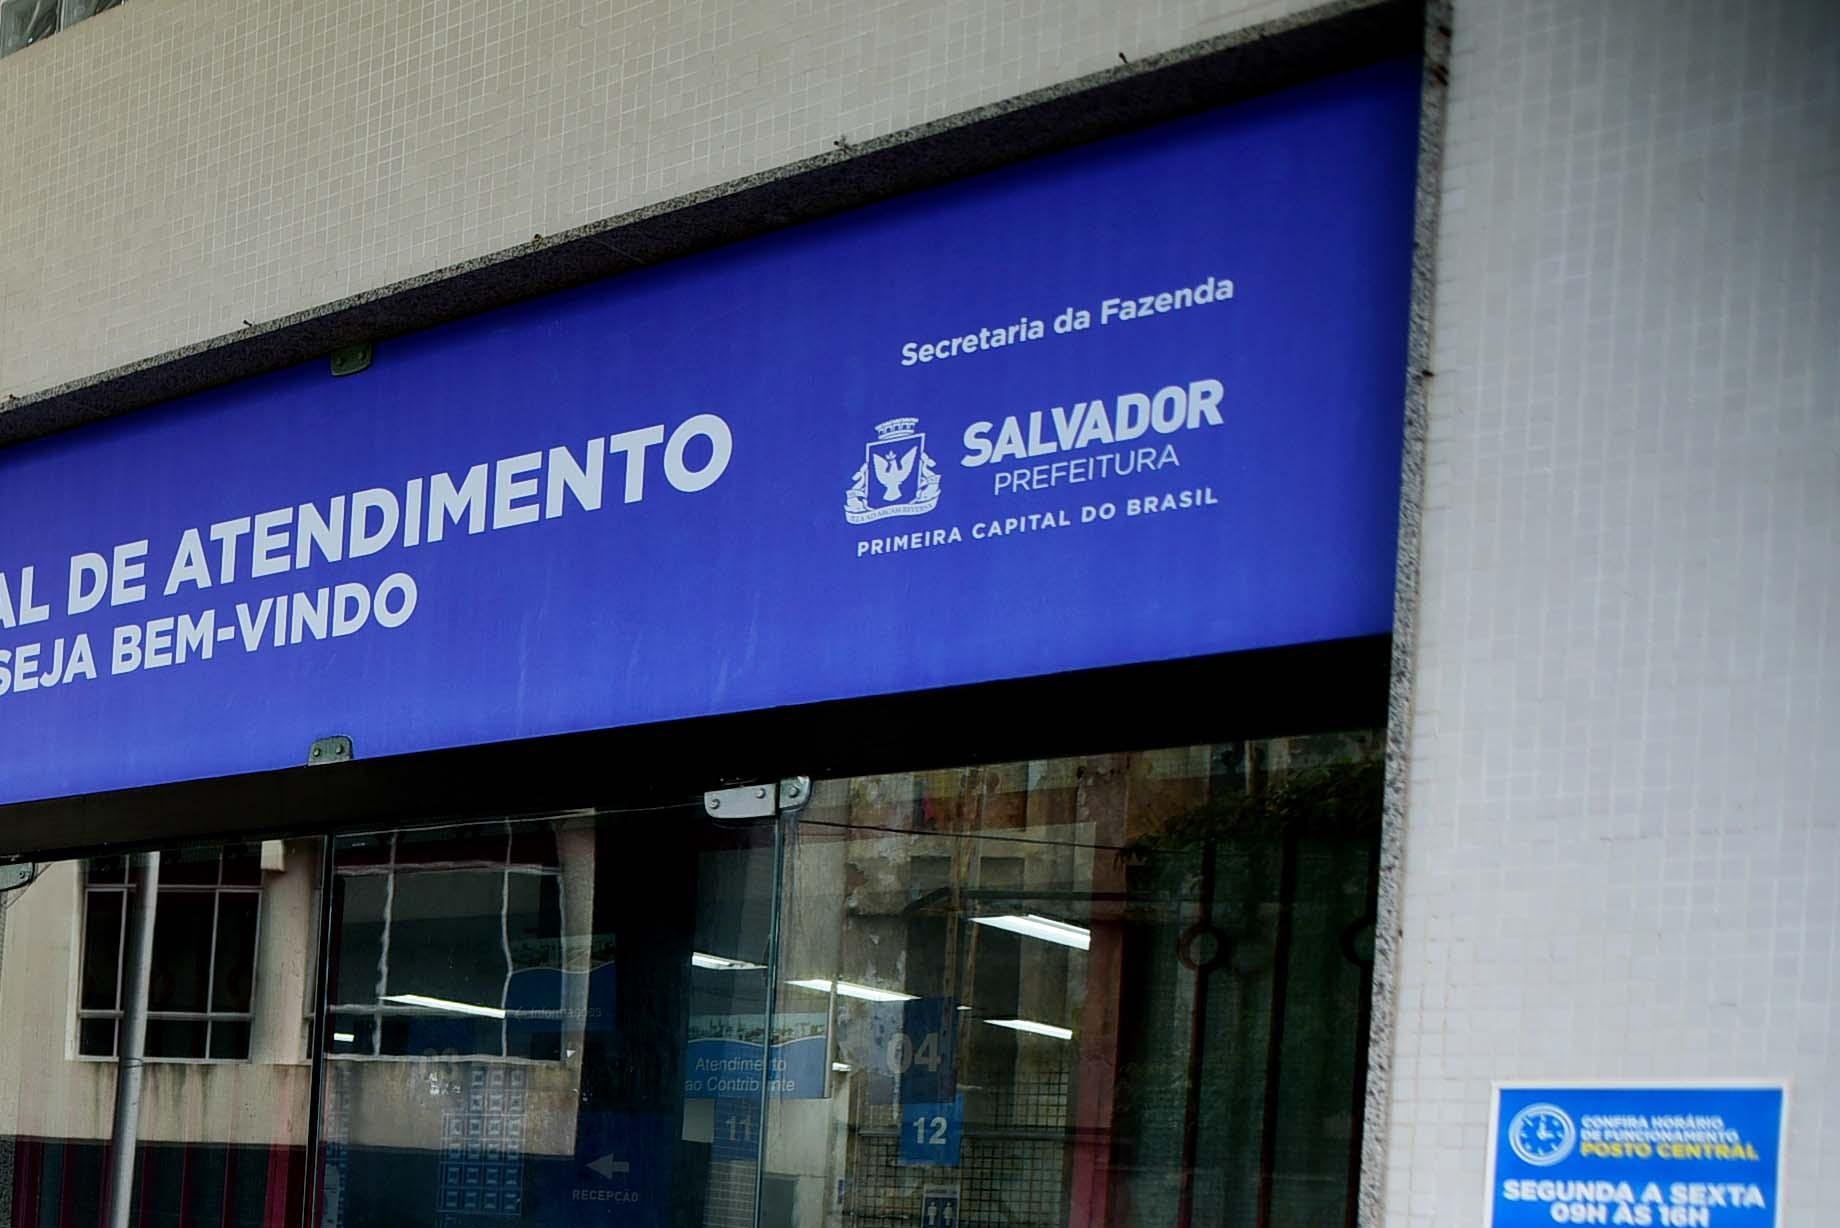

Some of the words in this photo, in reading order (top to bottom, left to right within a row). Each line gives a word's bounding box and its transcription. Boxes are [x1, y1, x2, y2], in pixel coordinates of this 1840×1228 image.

[901, 317, 1045, 366] Secretaria
[1053, 305, 1091, 335] da
[1101, 276, 1234, 325] Fazenda
[961, 379, 1224, 467] SALVADOR
[994, 444, 1180, 496] PREFEITURA
[66, 538, 148, 616] DE
[163, 413, 734, 597] ATENDIMENTO
[857, 526, 962, 557] PRIMEIRA
[972, 510, 1070, 540] CAPITAL
[1081, 502, 1116, 522] DO
[1127, 487, 1218, 516] BRASIL
[111, 572, 418, 676] BEM-VINDO
[696, 1057, 787, 1072] Atendimeto
[887, 1033, 942, 1073] 04
[913, 1116, 948, 1144] 12
[1581, 1128, 1601, 1141] DE
[1580, 1142, 1653, 1157] POSTO
[1656, 1143, 1760, 1160] CENTRAL
[1503, 1179, 1634, 1204] SEGUNDA
[1640, 1181, 1664, 1206] A
[1669, 1182, 1767, 1209] SEXTA
[1550, 1203, 1608, 1225] 09H
